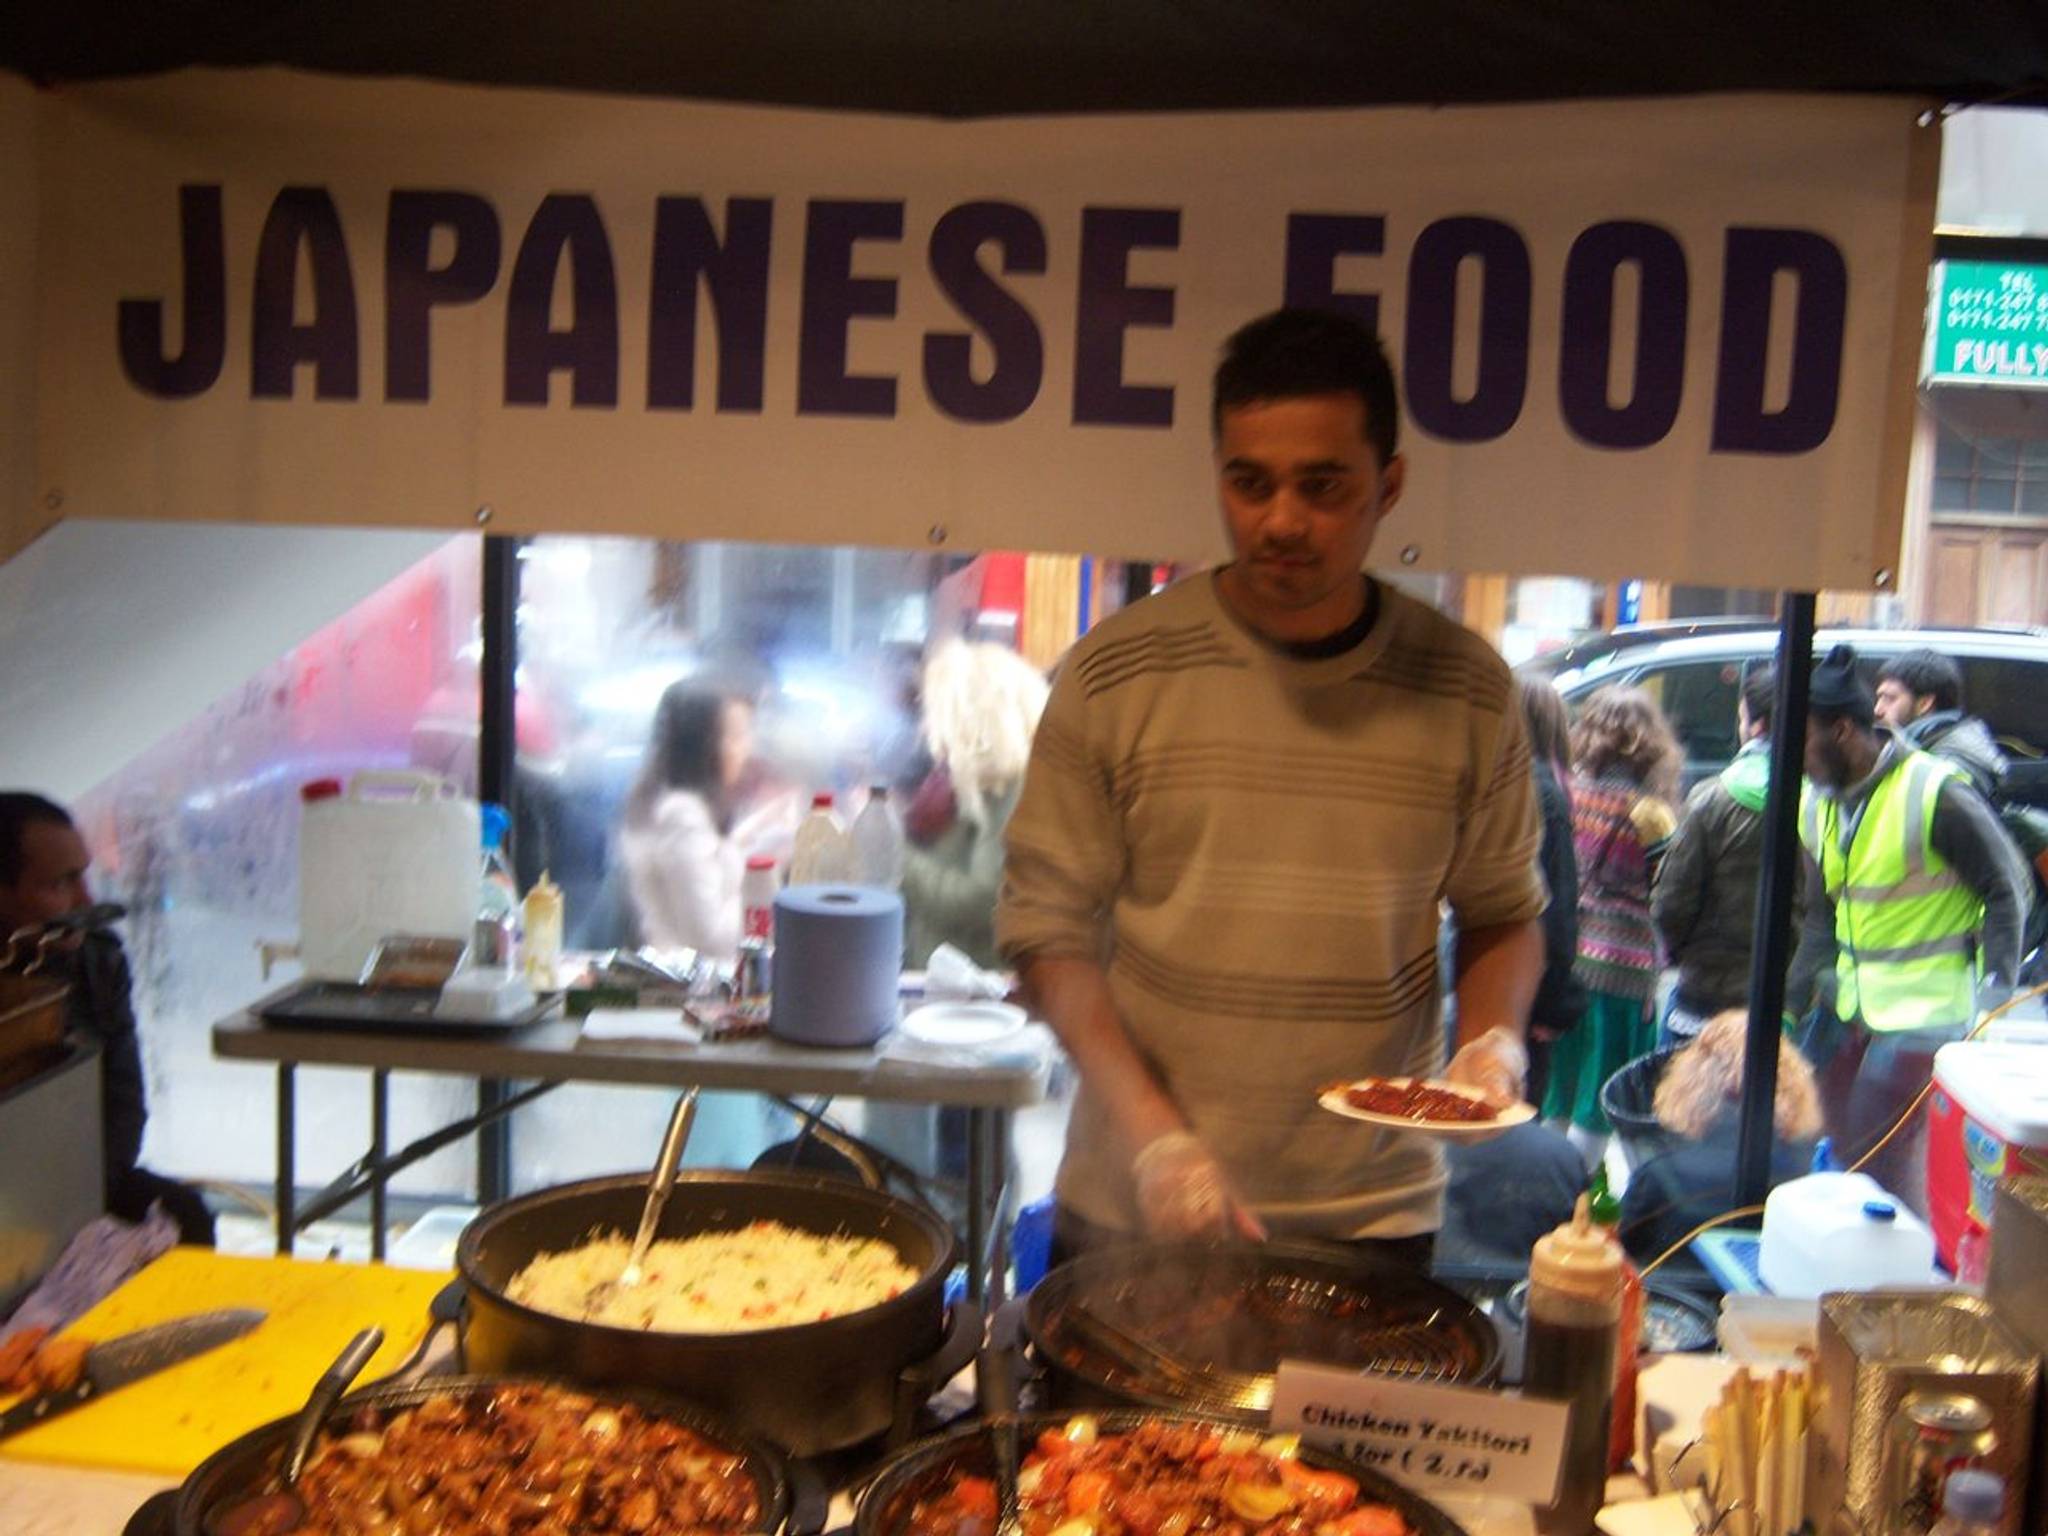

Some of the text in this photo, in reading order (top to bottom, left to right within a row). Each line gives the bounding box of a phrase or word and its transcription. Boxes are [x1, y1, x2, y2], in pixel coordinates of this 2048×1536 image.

[117, 183, 1847, 456] JAPANESE FOOD
[1953, 338, 2048, 376] FULLY
[1302, 1404, 1531, 1455] Chicken Yakitori
